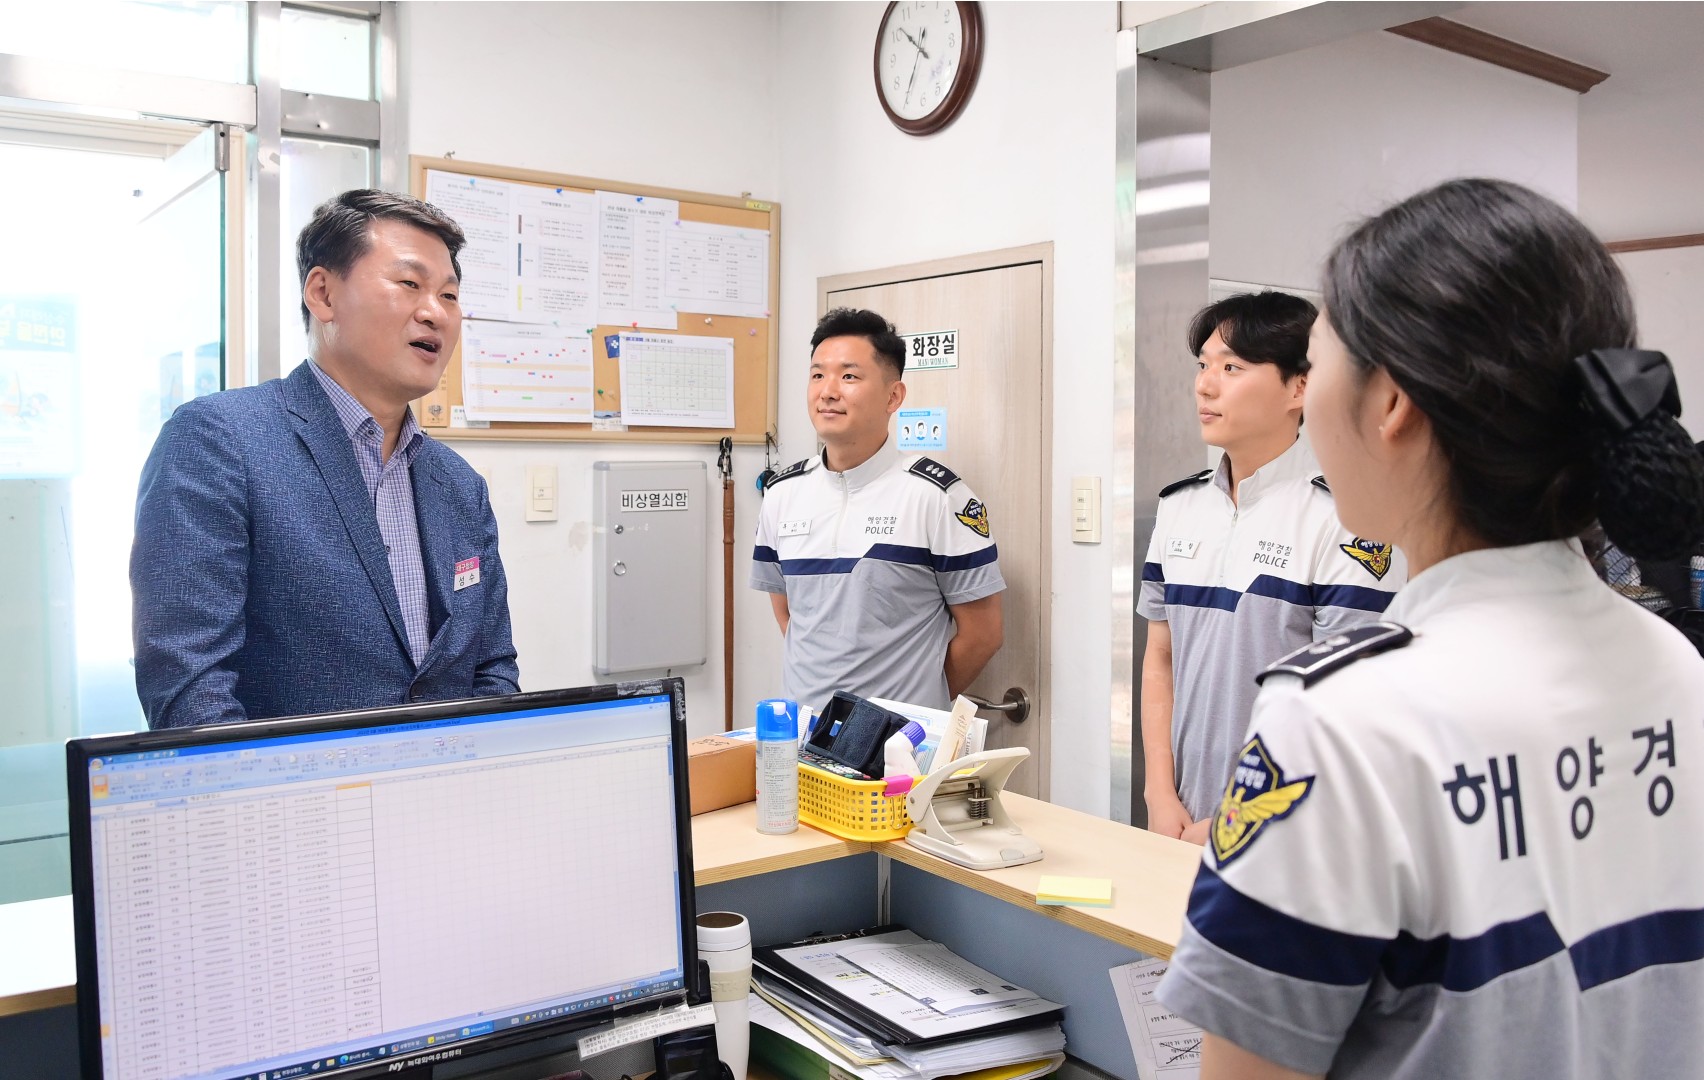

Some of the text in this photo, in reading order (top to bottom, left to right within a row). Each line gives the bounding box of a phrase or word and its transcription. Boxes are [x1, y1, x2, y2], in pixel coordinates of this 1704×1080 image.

[891, 27, 903, 43] 10
[948, 32, 956, 48] 3
[912, 333, 956, 358] 화장실
[622, 492, 688, 509] 비상열쇠함
[867, 516, 897, 525] 해양경찰
[864, 526, 895, 535] POLICE
[1258, 540, 1292, 557] 해양경찰
[1252, 552, 1289, 569] POLICE
[1442, 718, 1704, 861] 해양경
[407, 1048, 462, 1067] 늑대와여우컴퓨터
